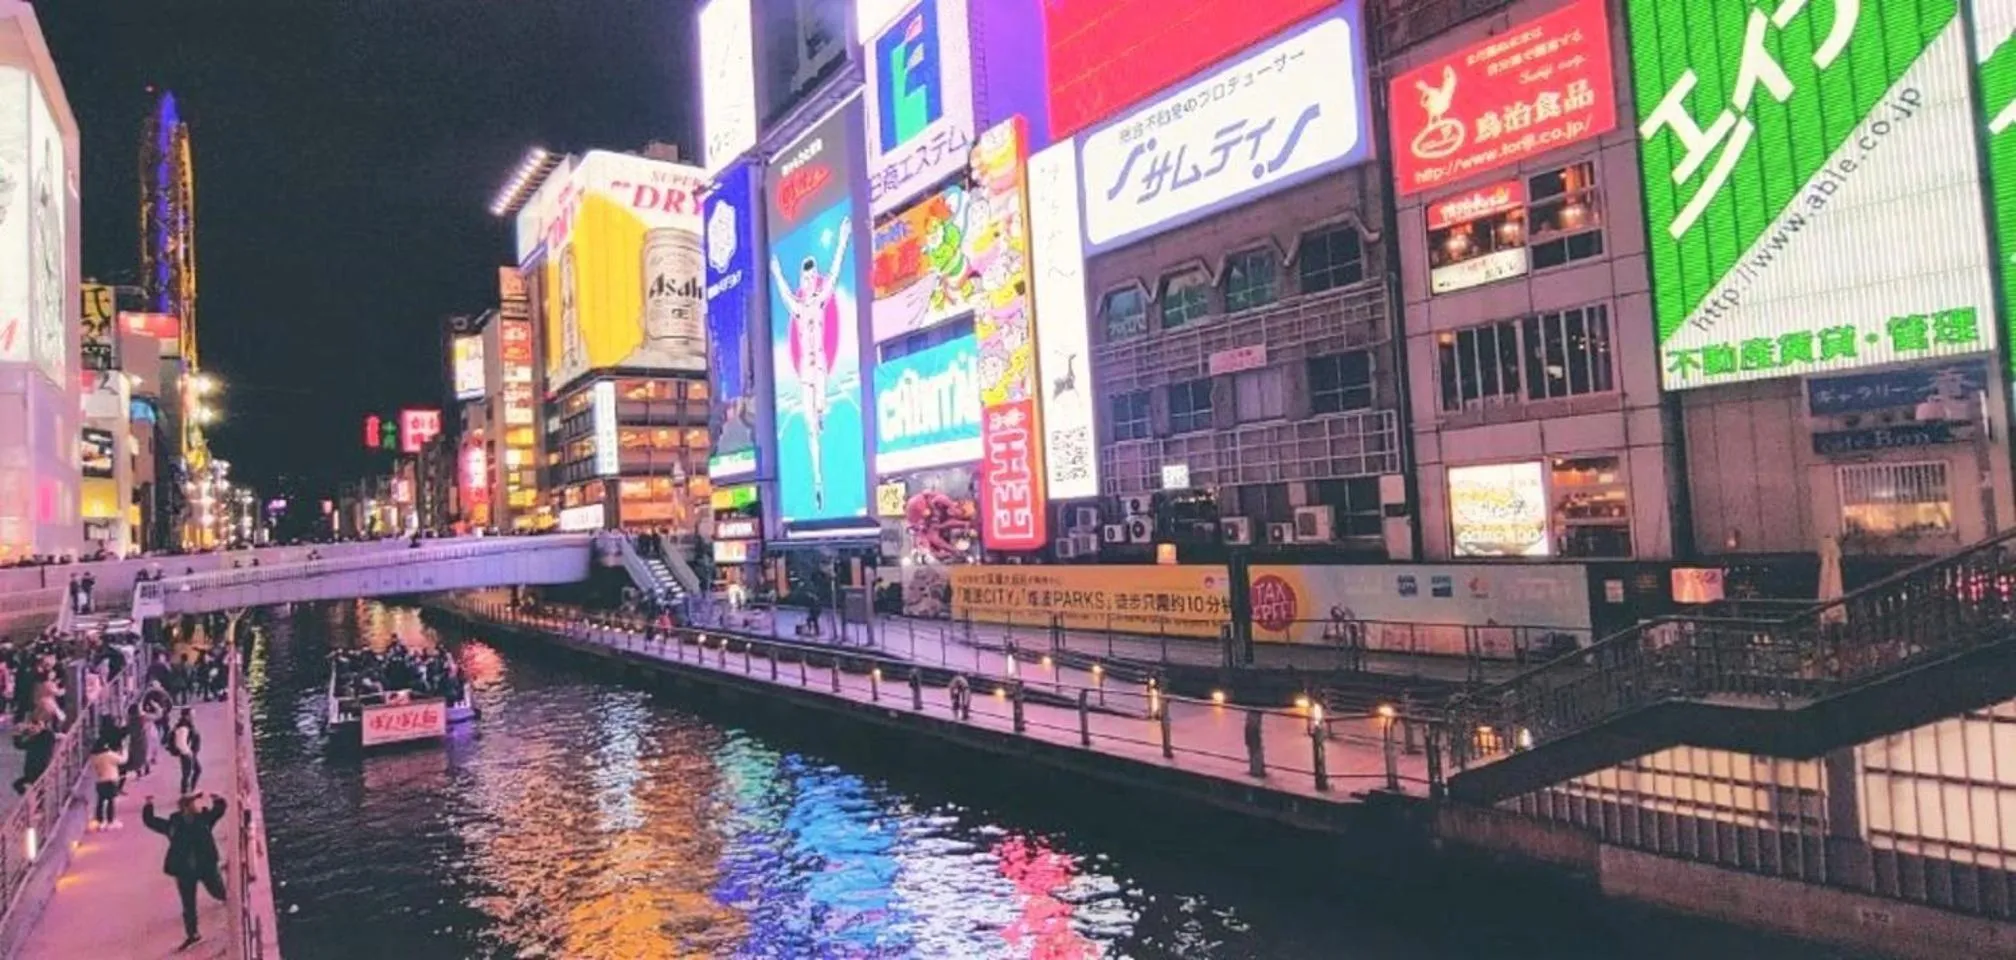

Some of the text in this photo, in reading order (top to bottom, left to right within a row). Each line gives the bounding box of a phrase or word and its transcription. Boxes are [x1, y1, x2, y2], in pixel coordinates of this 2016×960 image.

[1691, 83, 1922, 333] http://www.able.co.jp
[648, 273, 704, 299] Asah
[1665, 305, 1981, 380] 不動産賃貸・管理
[1255, 582, 1287, 607] TAX
